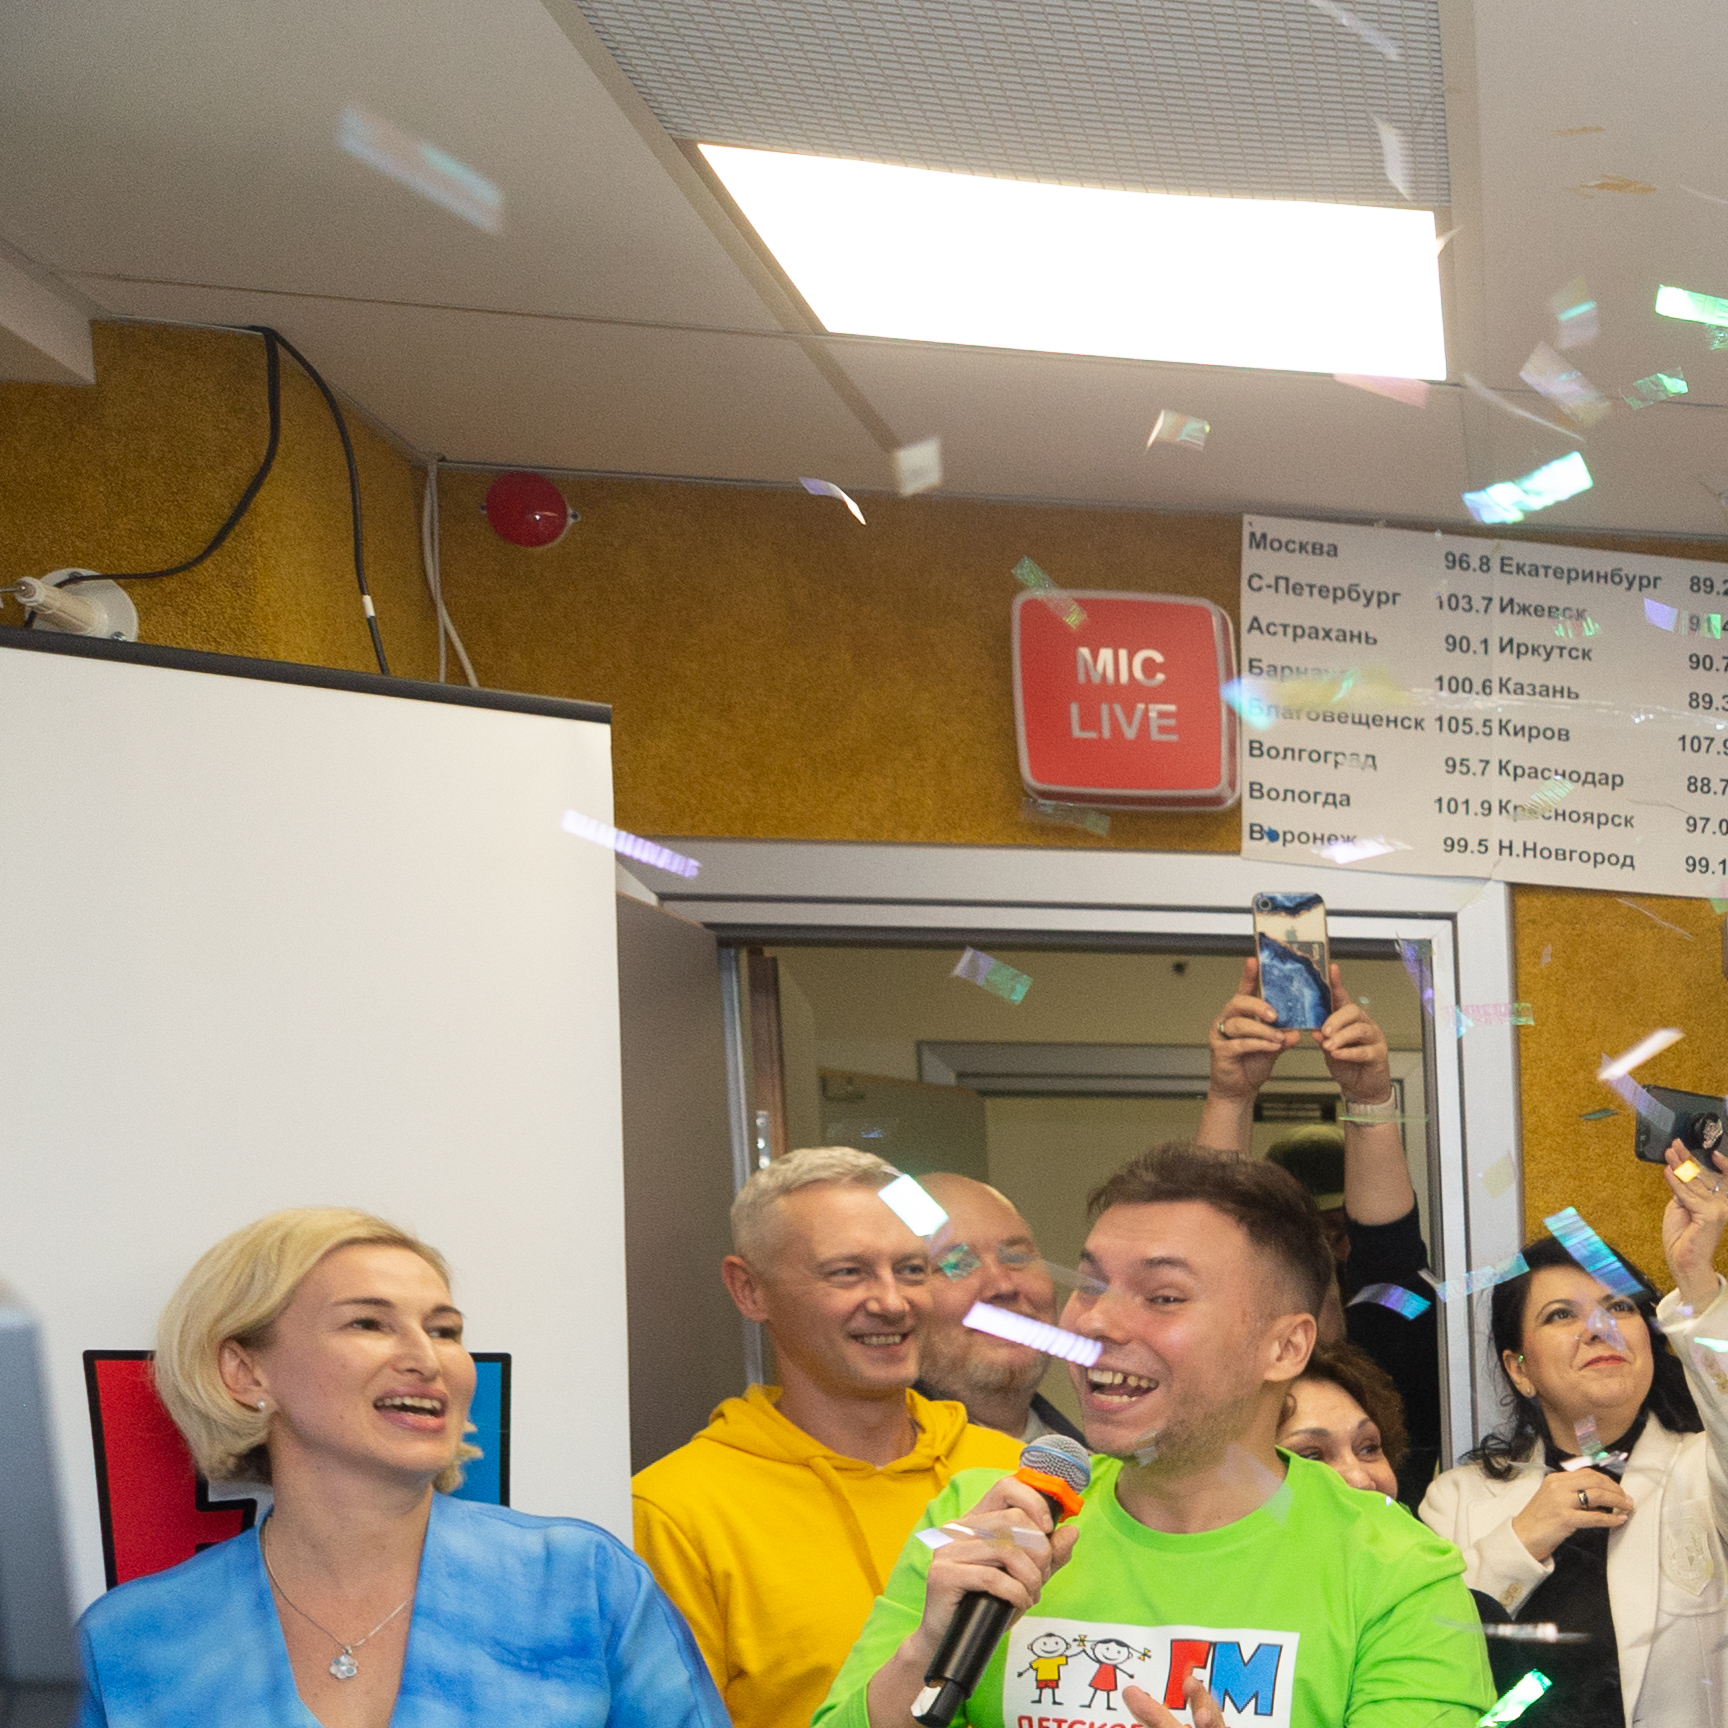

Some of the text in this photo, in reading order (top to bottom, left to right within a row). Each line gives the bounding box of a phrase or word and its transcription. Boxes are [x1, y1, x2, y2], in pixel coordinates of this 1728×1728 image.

[1248, 531, 1491, 574] Москва 96.8
[1500, 556, 1662, 592] Екатеринбург
[1247, 574, 1493, 615] С-Петербург 103.7
[1500, 596, 1587, 622] Ижевск
[1247, 616, 1490, 656] Астрахань 90.1
[1499, 637, 1593, 662] Иркутск
[1076, 645, 1166, 687] MIC
[1248, 657, 1493, 696] Барна 100.6
[1498, 677, 1580, 701] Казань
[1069, 701, 1180, 742] LIVE
[1435, 715, 1493, 737] 105.5
[1498, 719, 1570, 743] Киров
[1249, 740, 1490, 777] Волгоград 95.7
[1498, 759, 1624, 791] Краснодар
[1249, 782, 1493, 817] Вологда 101.9
[1498, 799, 1635, 830] Крсноярск
[1249, 823, 1489, 855] Вронеж 99.5
[1498, 839, 1728, 876] Н.Новгород 99.1
[1163, 1638, 1283, 1717] FM
